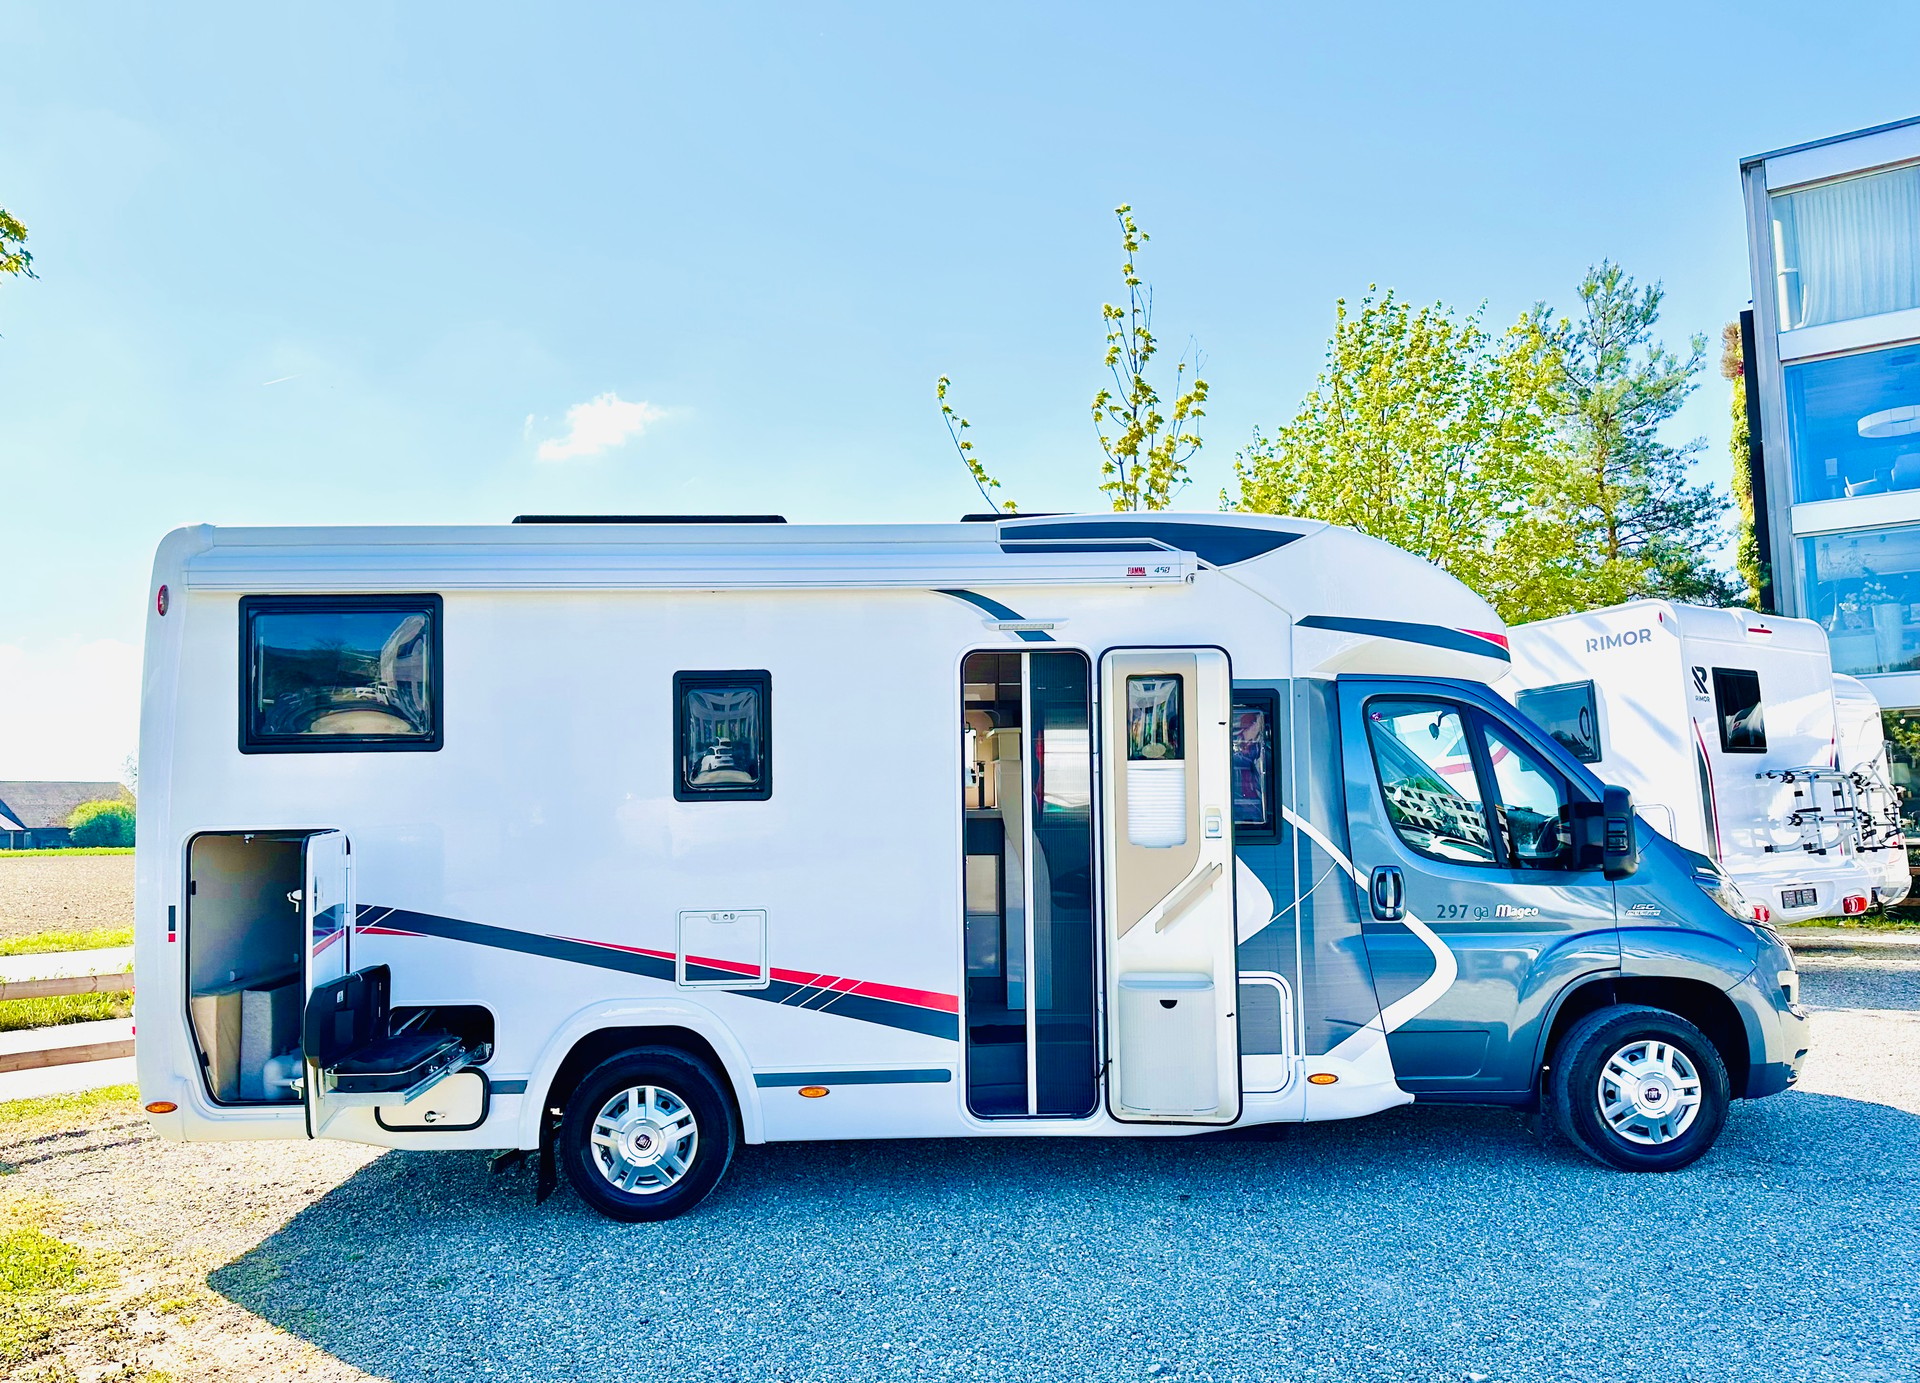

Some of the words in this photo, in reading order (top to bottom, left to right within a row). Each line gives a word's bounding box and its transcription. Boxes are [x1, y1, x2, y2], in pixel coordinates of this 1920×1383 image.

[1127, 566, 1146, 575] FIAMMA
[1585, 628, 1652, 653] RIMOR
[1436, 904, 1469, 919] 297
[1473, 906, 1489, 921] ga
[1494, 903, 1540, 920] Mageo
